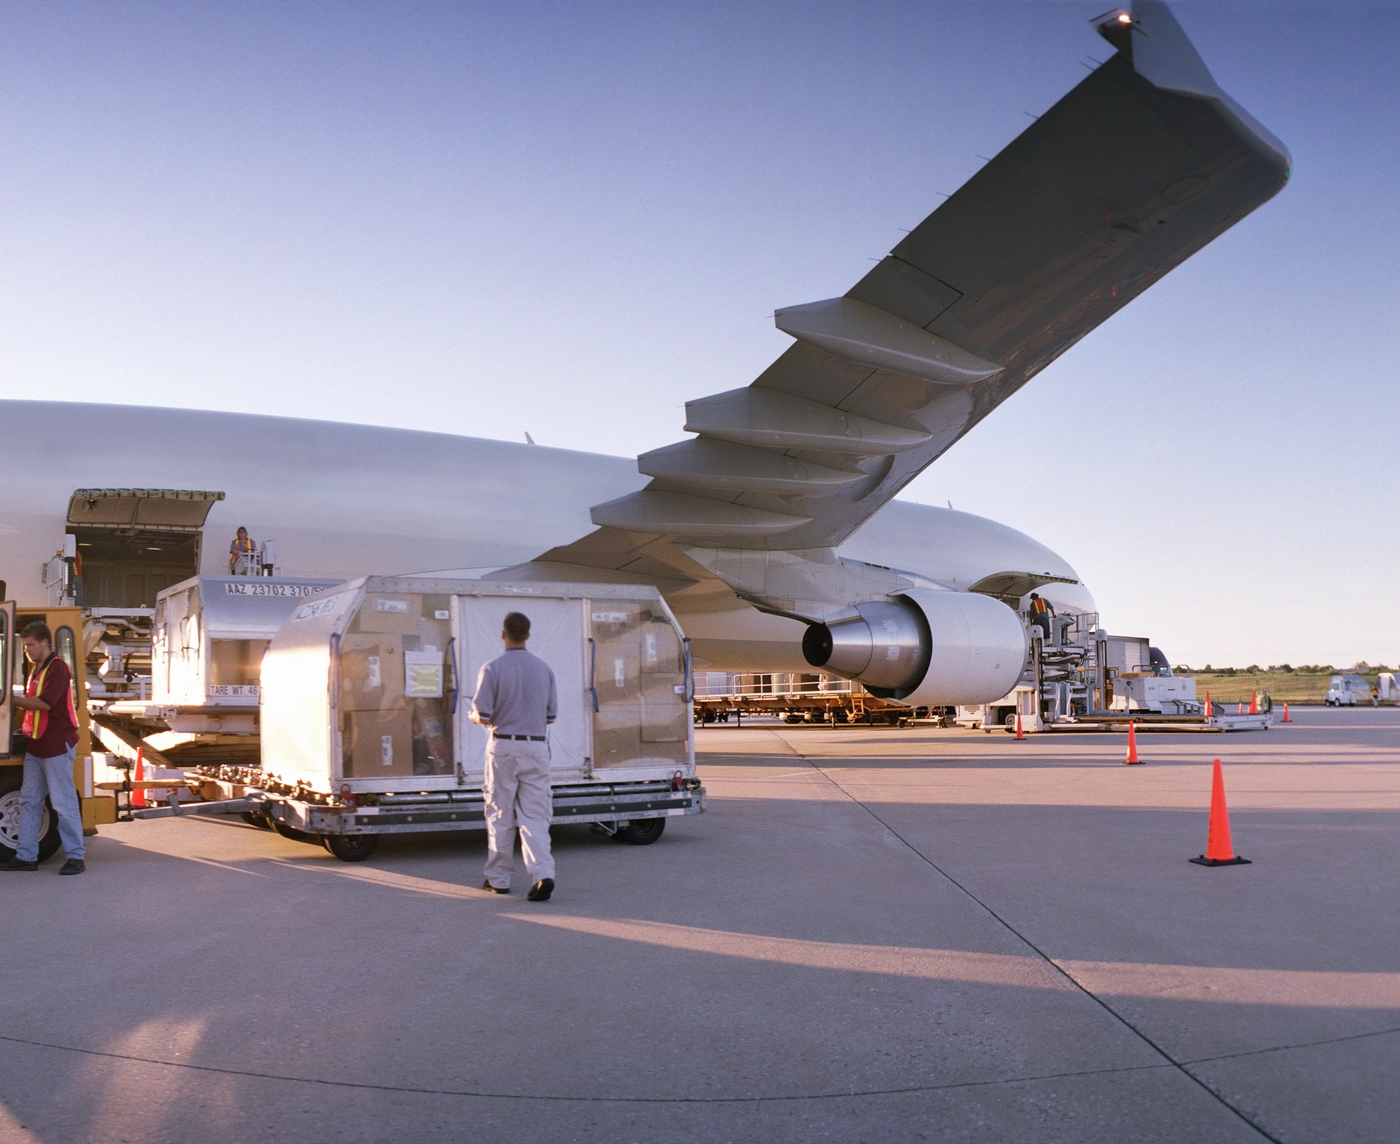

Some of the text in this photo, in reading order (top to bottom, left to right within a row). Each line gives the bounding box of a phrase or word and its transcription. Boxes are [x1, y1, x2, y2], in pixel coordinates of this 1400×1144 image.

[227, 583, 247, 595] AAZ
[251, 584, 286, 596] 23702
[210, 685, 229, 695] TARE
[231, 686, 246, 695] WT.
